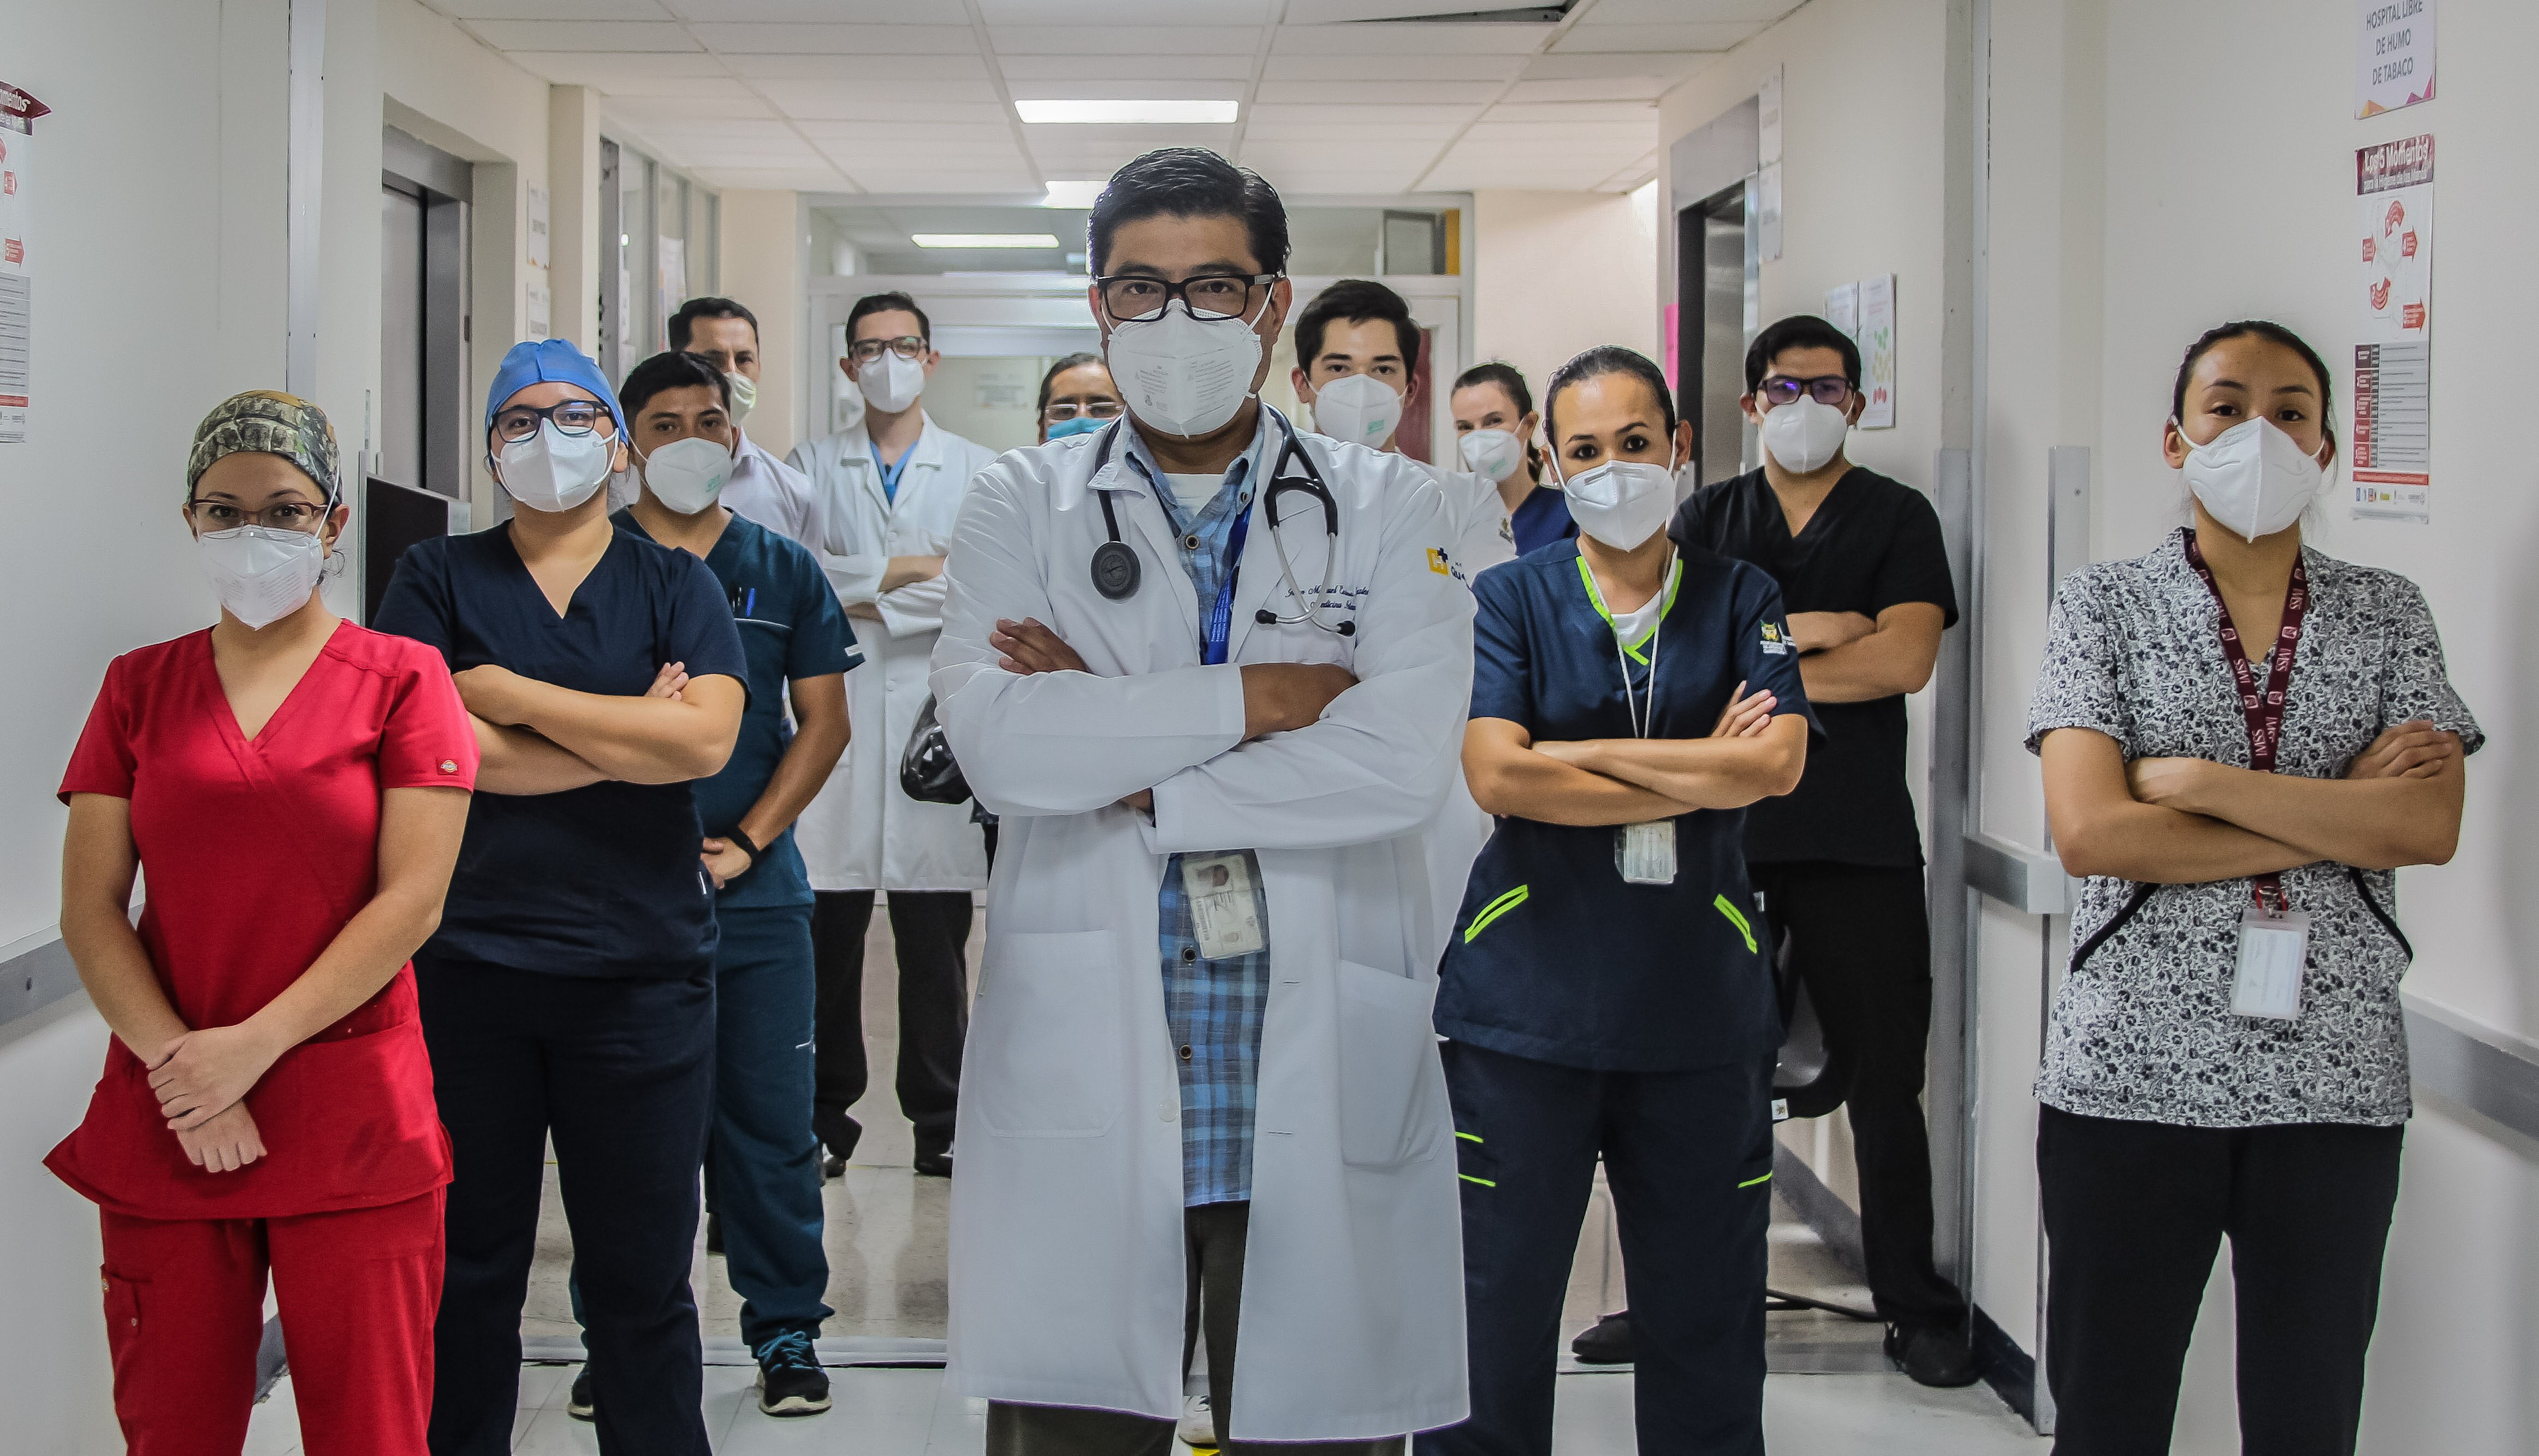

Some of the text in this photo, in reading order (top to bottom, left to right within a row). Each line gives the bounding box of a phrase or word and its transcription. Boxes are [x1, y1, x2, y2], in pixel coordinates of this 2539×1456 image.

[2366, 0, 2423, 30] HOSPITAL LIBRE
[2376, 28, 2411, 56] DE HUMO
[2372, 57, 2413, 85] DE TABACO
[2233, 658, 2251, 684] IMSS
[2252, 729, 2267, 756] IMSS
